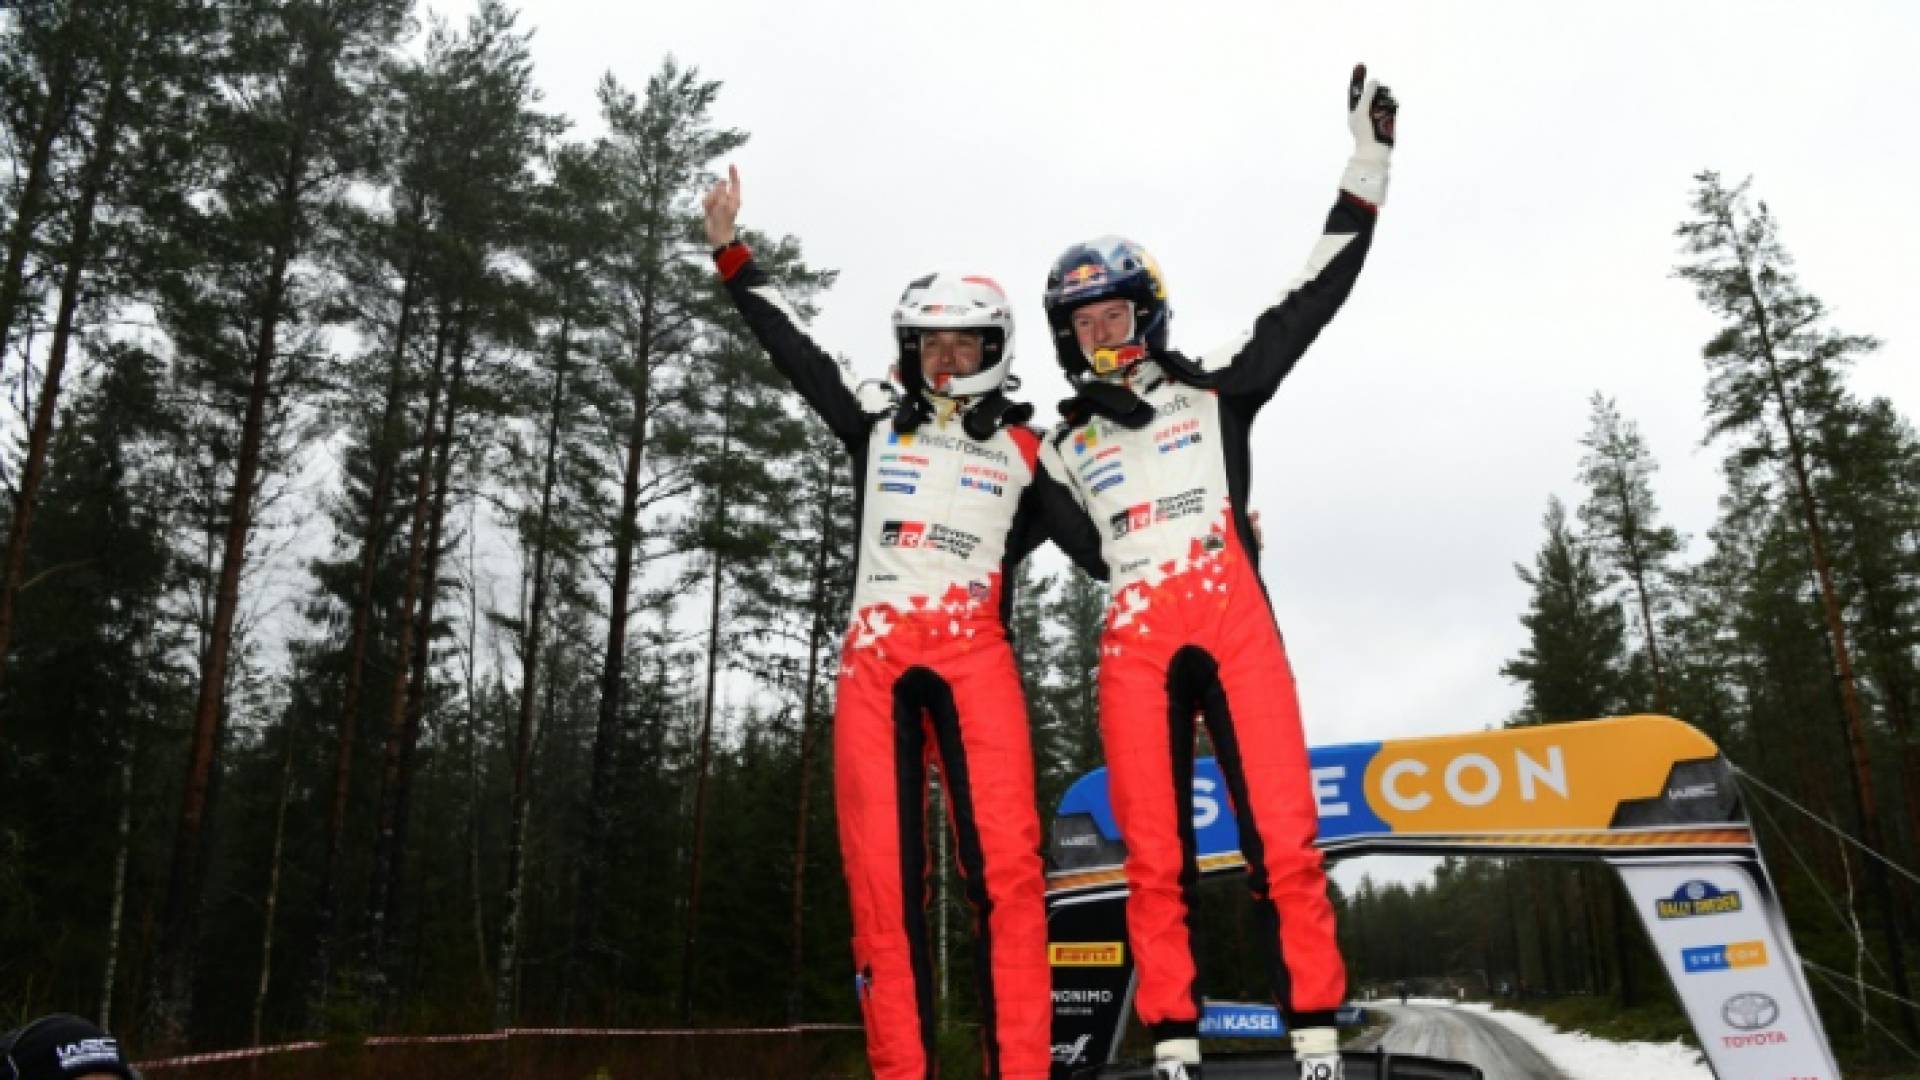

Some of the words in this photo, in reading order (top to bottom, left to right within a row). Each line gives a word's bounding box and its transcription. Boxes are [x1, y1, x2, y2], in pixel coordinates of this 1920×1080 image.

[1192, 745, 1569, 829] SECON
[1660, 900, 1692, 917] RALLY
[1695, 893, 1739, 913] SWEDEN
[1055, 946, 1117, 962] PIRELLI
[1051, 990, 1113, 1002] NONIMO
[56, 1038, 117, 1058] WRC
[1721, 1031, 1787, 1048] TOYOTA
